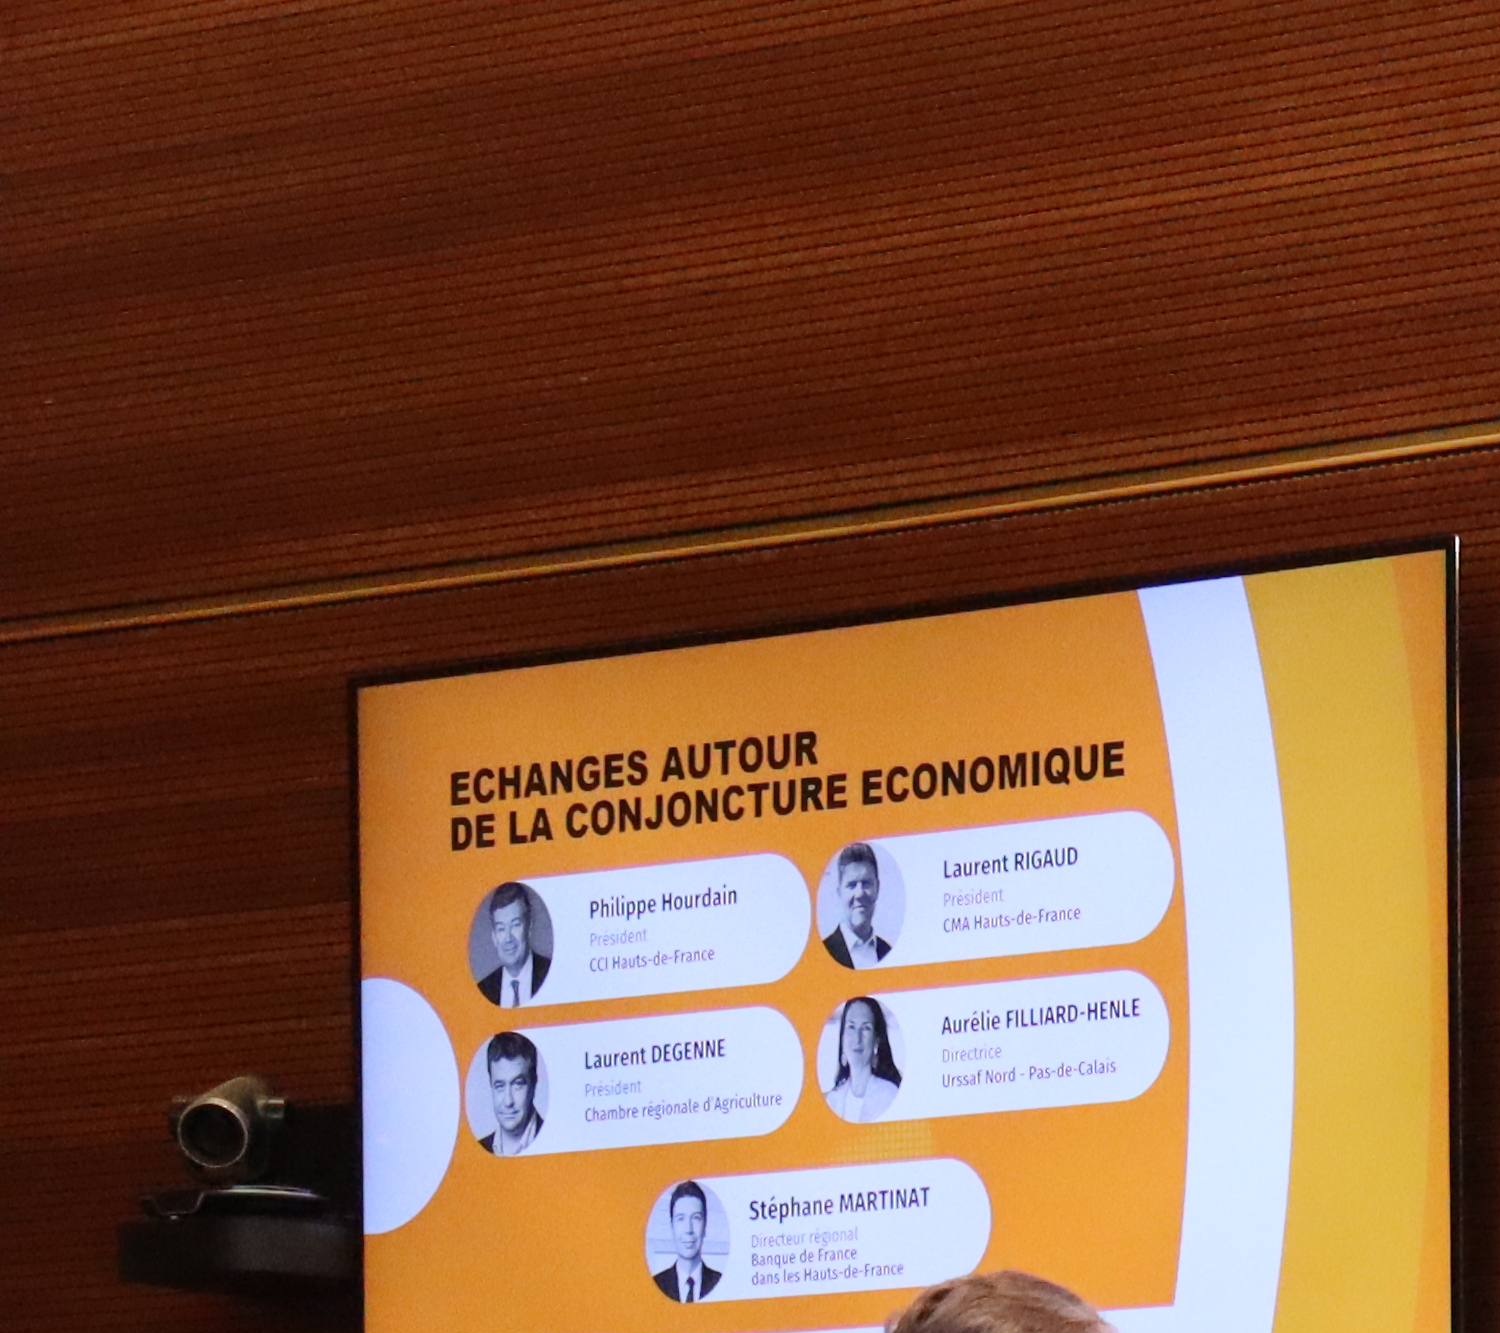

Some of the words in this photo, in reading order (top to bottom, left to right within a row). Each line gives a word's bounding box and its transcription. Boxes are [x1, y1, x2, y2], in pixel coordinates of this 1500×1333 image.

[450, 750, 648, 806] ECHANGES
[661, 731, 818, 782] AUTOUR
[450, 814, 495, 851] DE
[508, 808, 554, 845] LA
[566, 773, 847, 839] CONJONCTURE
[861, 740, 1125, 806] ECONOMIQUE
[943, 852, 1009, 880] Laurent
[1014, 846, 1079, 873] RIGAUD
[589, 894, 656, 921] Philippe
[661, 884, 738, 912] Hourdain
[943, 887, 1005, 908] Président
[943, 916, 970, 934] CMA
[974, 905, 1082, 932] Hauts-de-France
[589, 927, 649, 948] Président
[589, 956, 609, 973] CCI
[612, 948, 716, 971] Hauts-de-France
[941, 1009, 1001, 1035] Aurélie
[1006, 998, 1141, 1029] FILLIARD-HENLE
[584, 1047, 647, 1071] Laurent
[651, 1038, 727, 1064] DEGENNE
[942, 1043, 1002, 1064] Directrice
[942, 1069, 983, 1089] Urssaf
[985, 1066, 1016, 1085] Nord
[1029, 1056, 1117, 1081] Pas-de-Calais
[584, 1079, 642, 1098] Président
[584, 1103, 639, 1123] Chambre
[642, 1097, 700, 1121] régionale
[703, 1092, 783, 1114] d'Agriculture
[749, 1195, 834, 1225] Stéphane
[839, 1186, 931, 1214] MARTINAT
[751, 1232, 807, 1249] Directeur
[809, 1226, 859, 1247] régional
[751, 1251, 797, 1269] Banque
[799, 1249, 815, 1264] de
[818, 1247, 858, 1263] France
[751, 1271, 781, 1286] dans
[783, 1269, 801, 1283] les
[804, 1262, 905, 1282] Hauts-de-France
